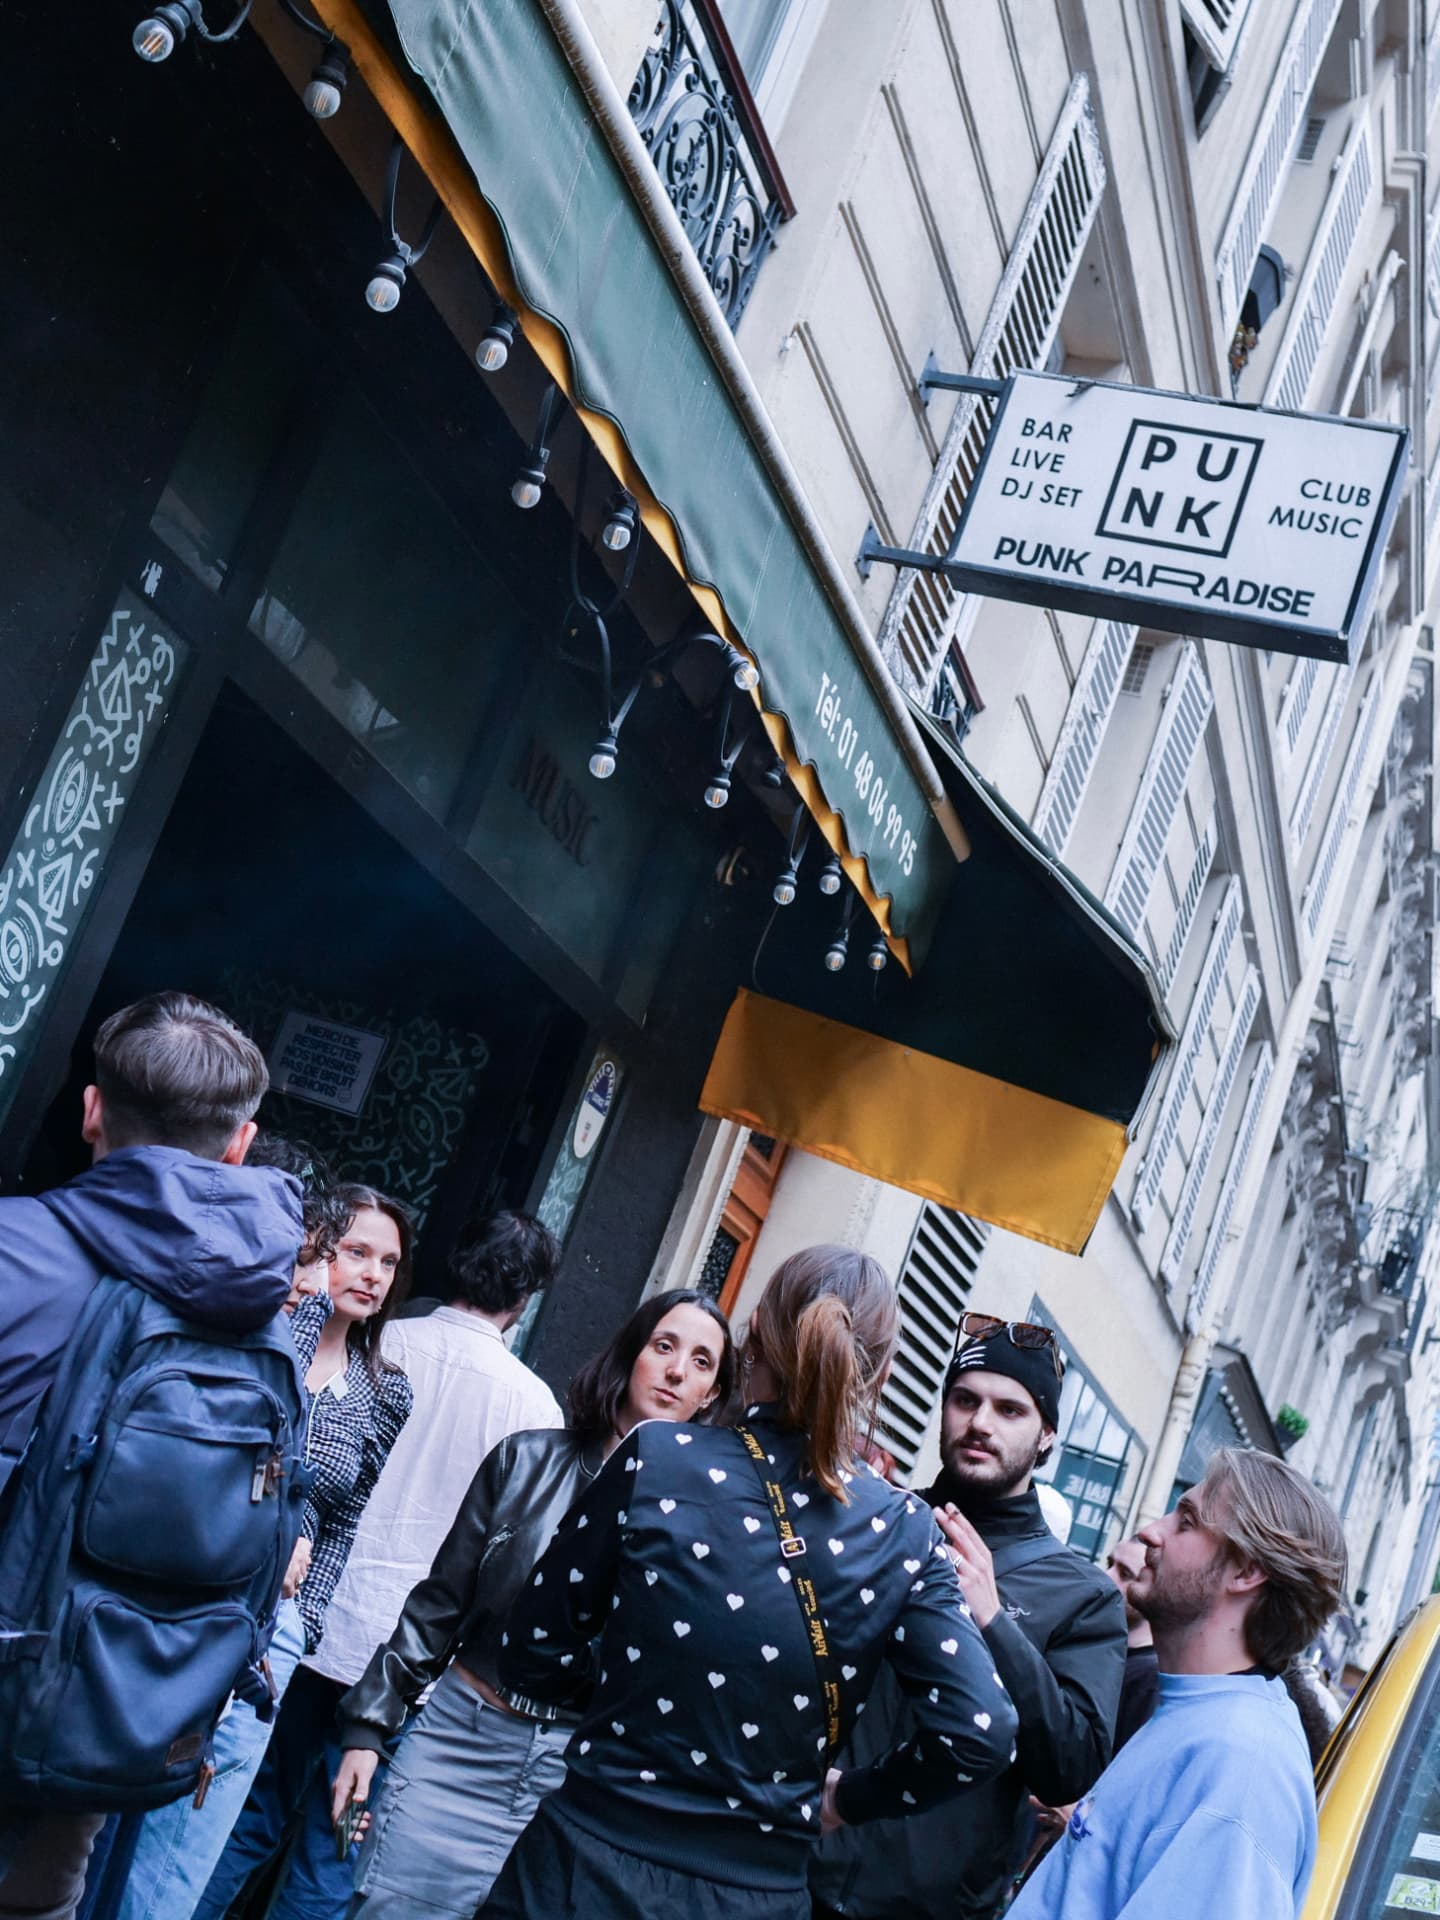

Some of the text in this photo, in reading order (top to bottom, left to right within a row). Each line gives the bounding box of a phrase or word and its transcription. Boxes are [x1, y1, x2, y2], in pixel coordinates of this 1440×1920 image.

[1020, 418, 1073, 444] BAR
[1010, 448, 1066, 473] LIVE
[1000, 478, 1082, 508] DJ SET
[1299, 479, 1372, 508] CLUB
[1267, 506, 1364, 539] MUSIC
[994, 536, 1316, 618] PUNK PARADISE
[815, 671, 918, 877] Tél: 01 48 06 99 95
[284, 1044, 310, 1061] NOS
[342, 1035, 360, 1048] DE
